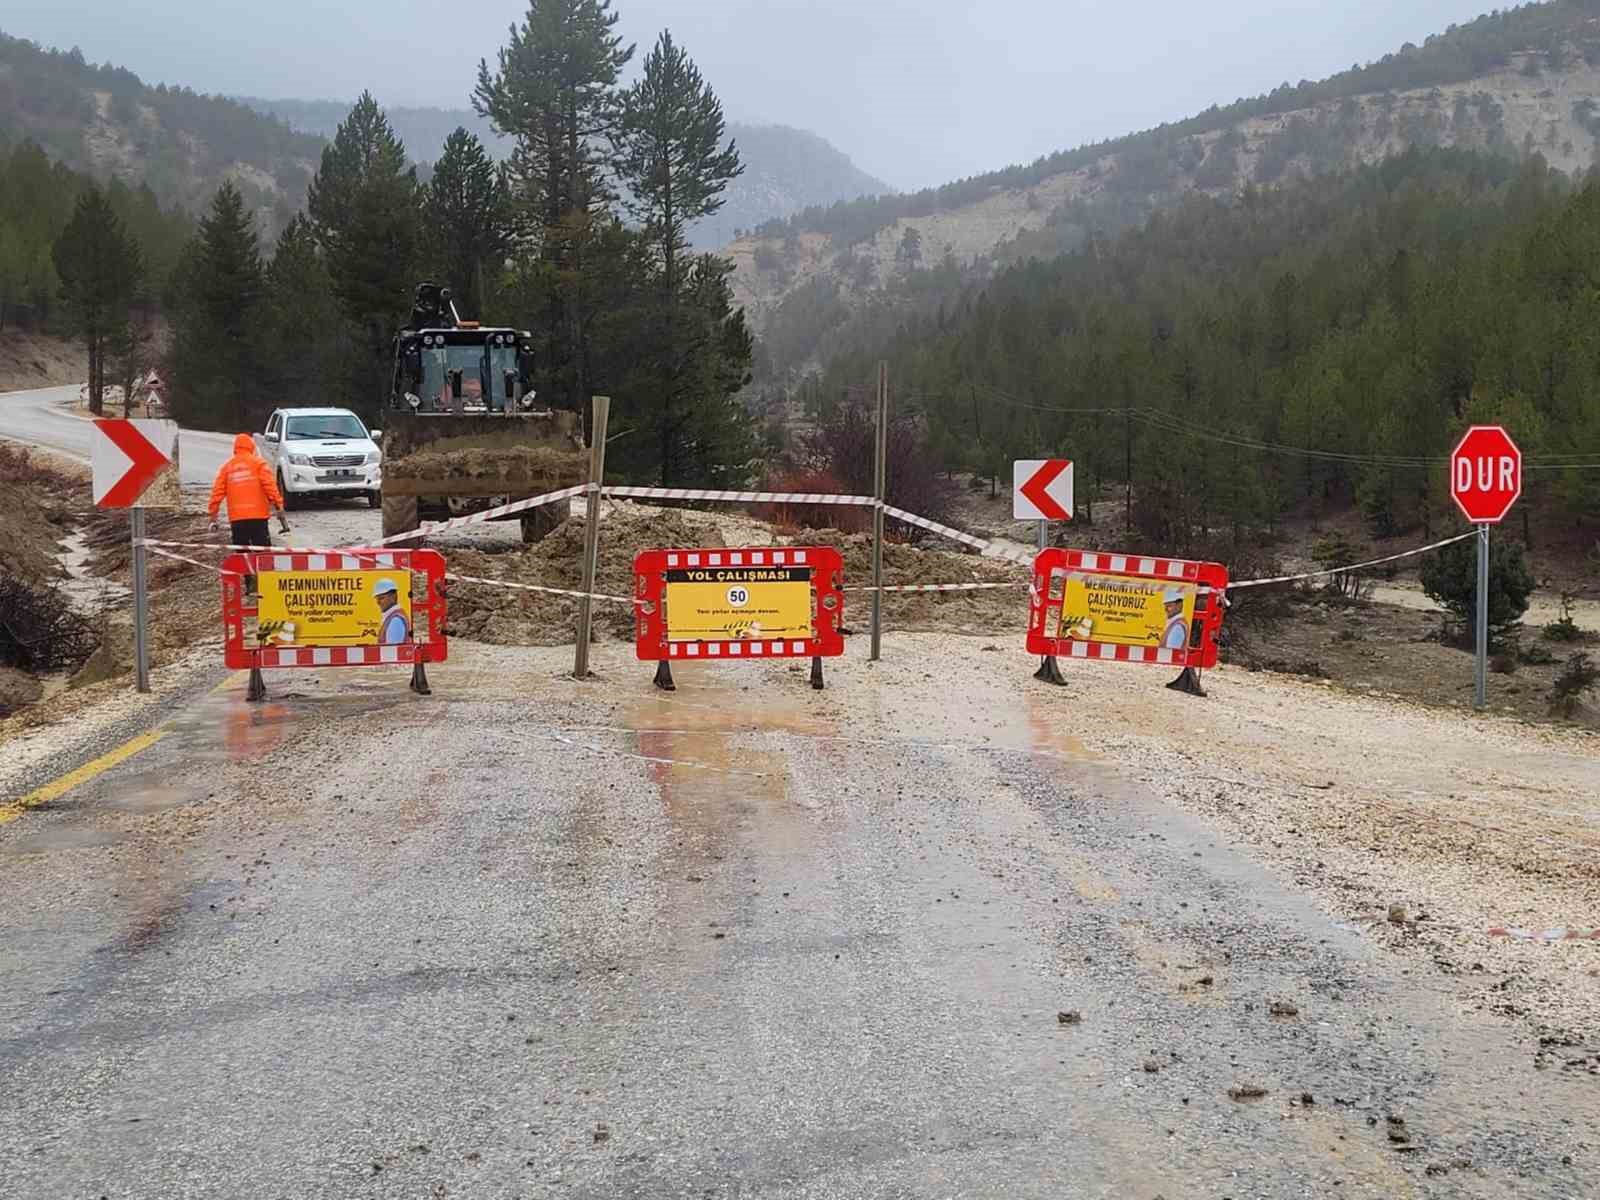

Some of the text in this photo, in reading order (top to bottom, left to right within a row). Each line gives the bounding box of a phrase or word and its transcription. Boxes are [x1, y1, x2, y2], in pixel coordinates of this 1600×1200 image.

[1457, 456, 1514, 492] DUR
[687, 571, 790, 582] YOL ÇALIŞMASI
[278, 576, 363, 591] MEMNUNİYETLE
[730, 590, 746, 602] 50
